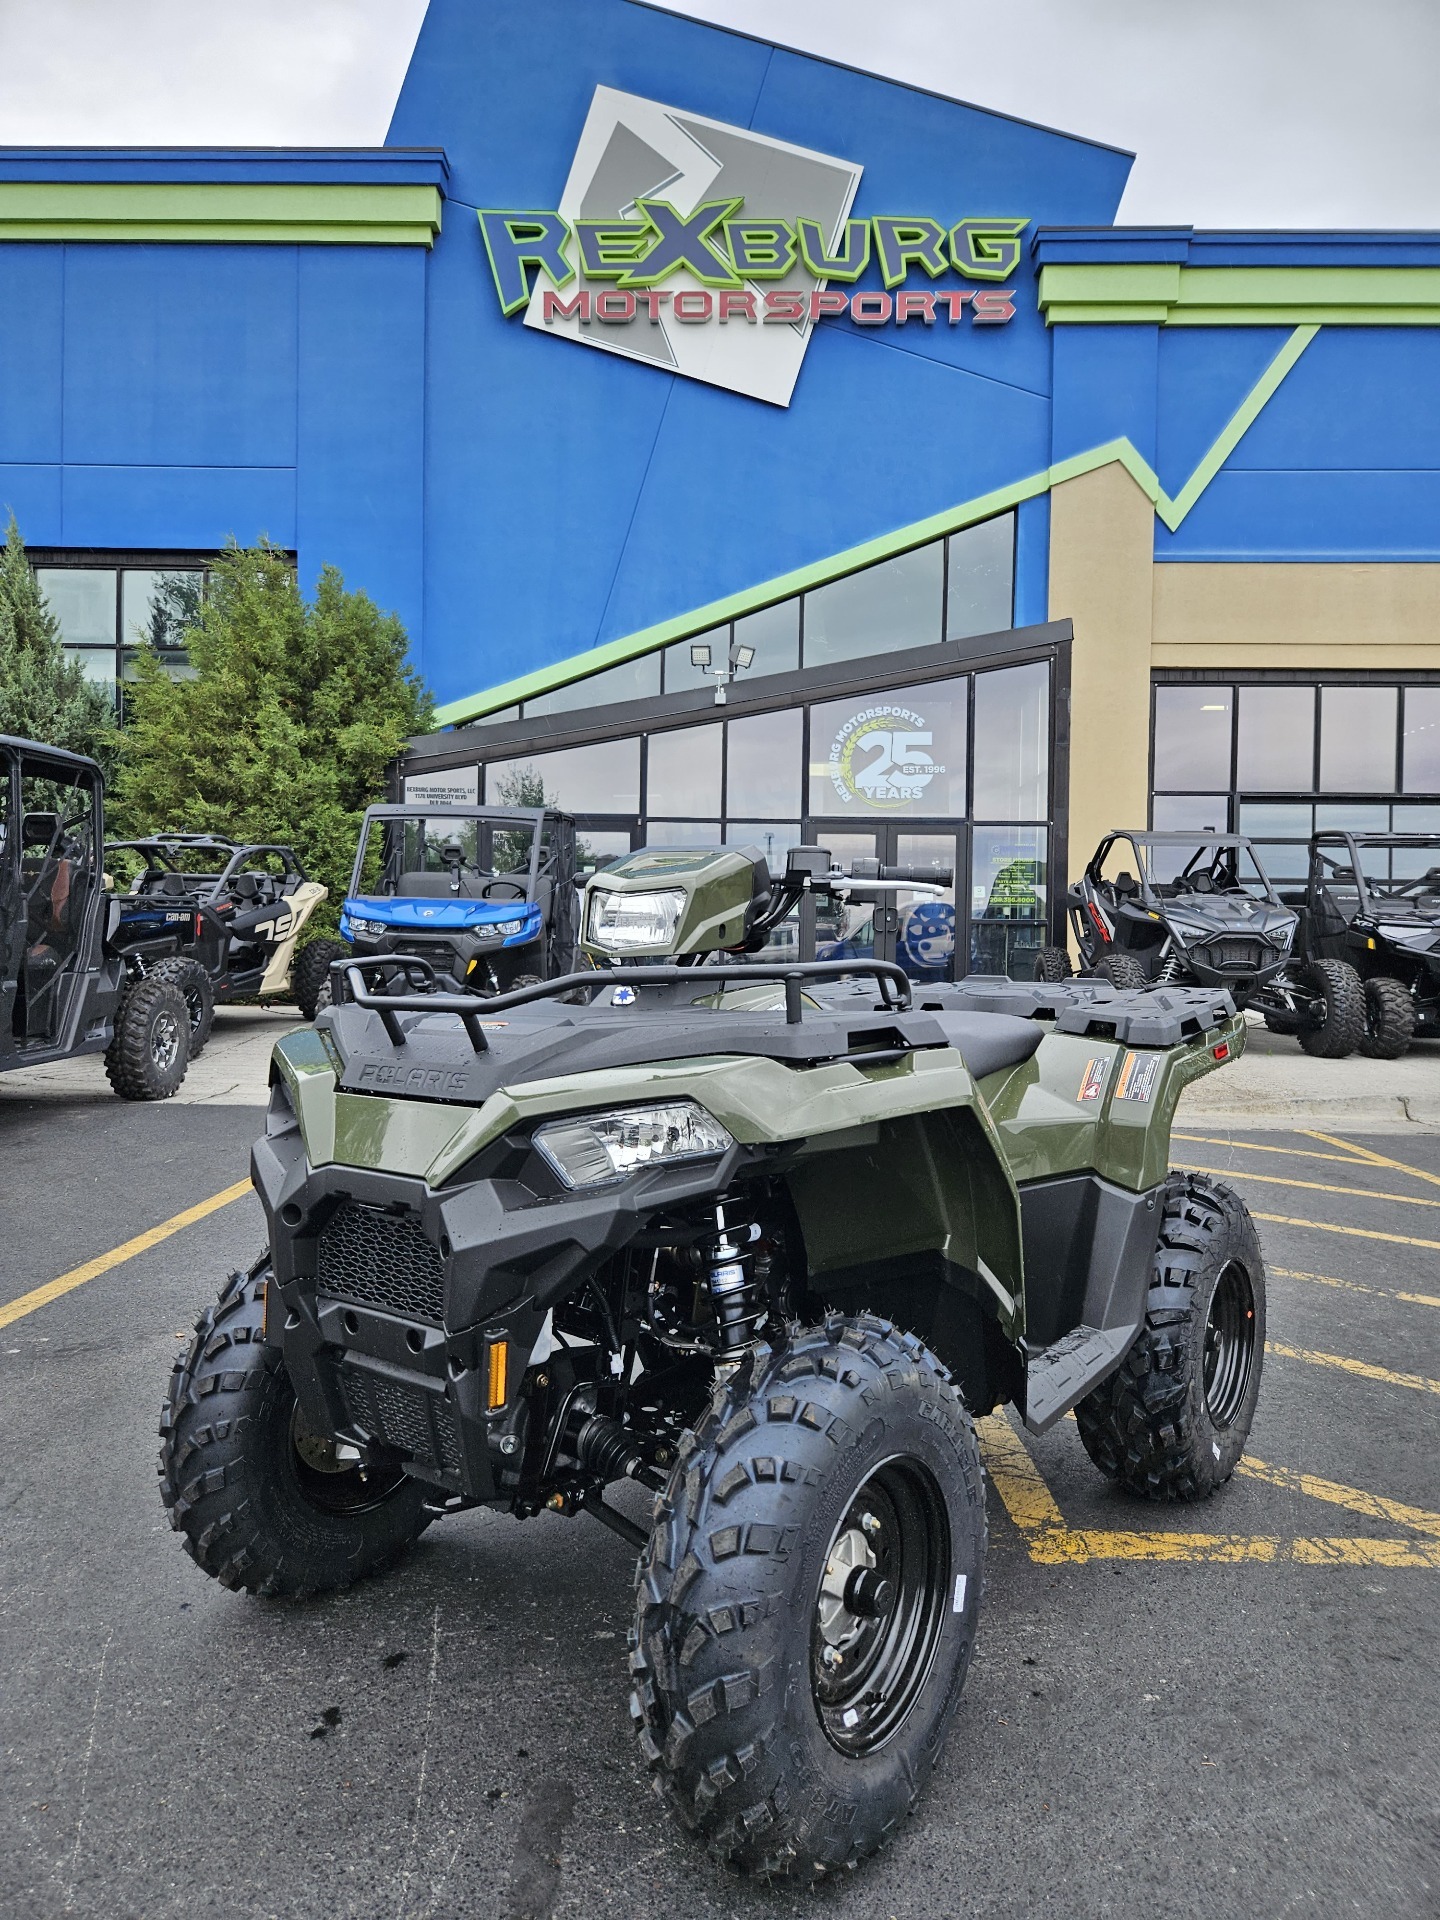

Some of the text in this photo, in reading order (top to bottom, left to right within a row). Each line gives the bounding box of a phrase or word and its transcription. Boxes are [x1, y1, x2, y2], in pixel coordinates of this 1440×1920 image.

[477, 196, 1031, 317] REXBURG
[542, 289, 1017, 325] MOTORSPORTS
[828, 706, 926, 803] REXBURG MOTORSPORTS
[854, 731, 935, 789] 25
[902, 766, 946, 774] EST. 1996
[863, 786, 923, 799] YEARS
[165, 912, 191, 922] can-am
[358, 1063, 470, 1092] POLARIS
